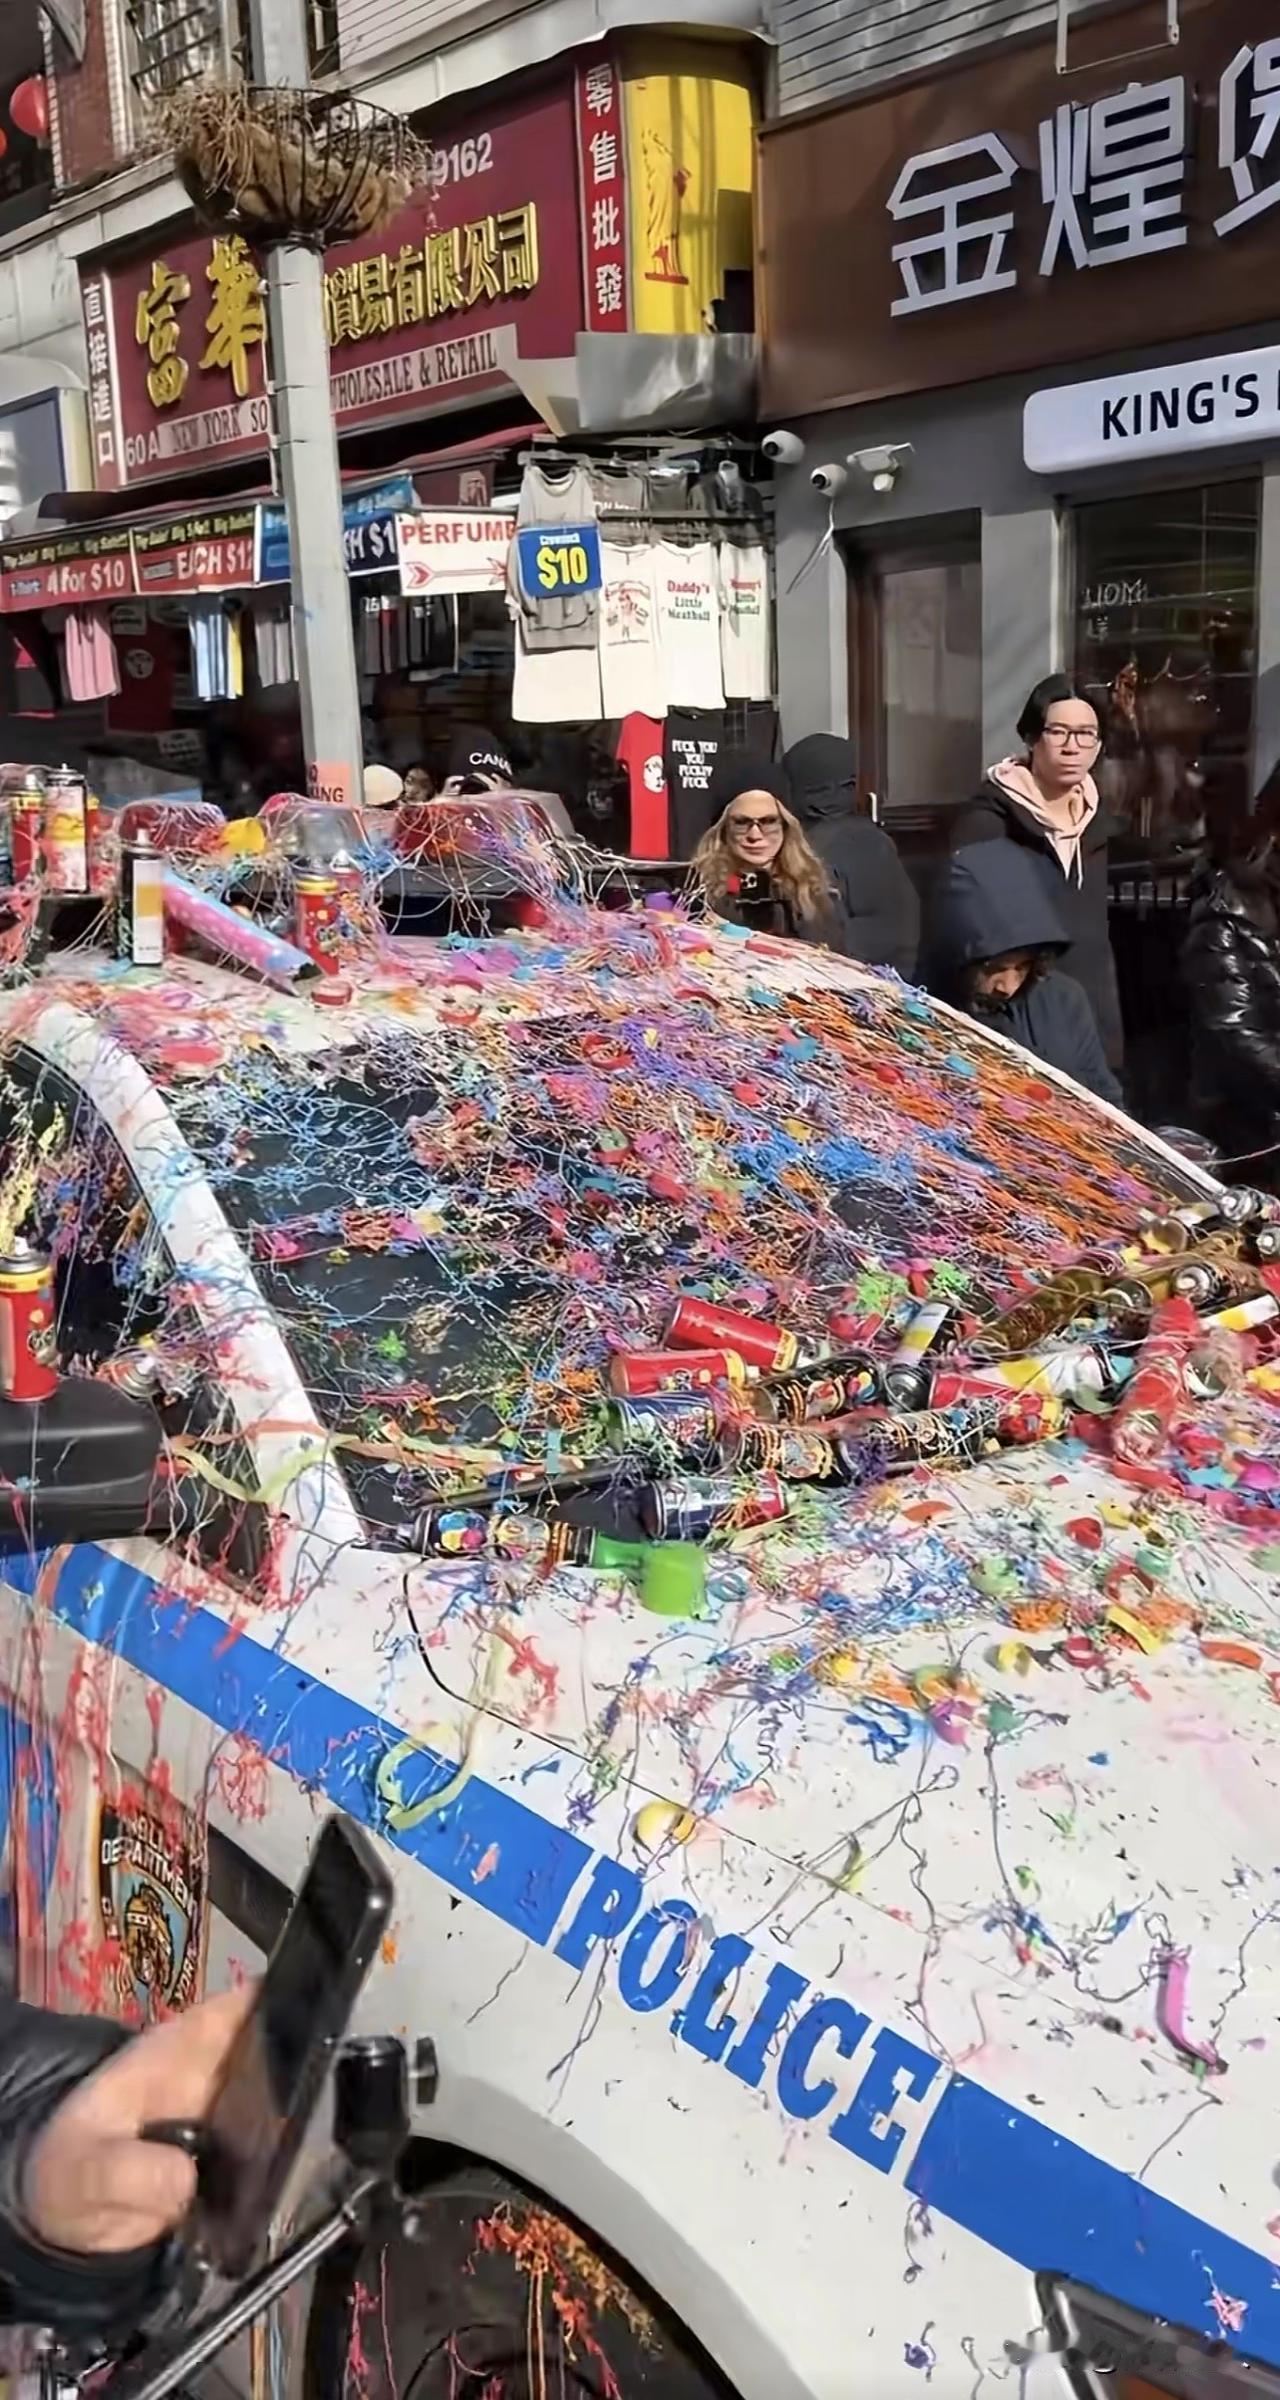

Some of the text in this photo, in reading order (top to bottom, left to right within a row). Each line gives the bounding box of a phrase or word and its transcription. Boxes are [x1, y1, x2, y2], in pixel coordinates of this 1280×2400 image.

[587, 63, 622, 314] 零售批發
[203, 404, 242, 445] YORK
[419, 350, 431, 388] &
[435, 332, 498, 384] RETAIL
[1103, 373, 1259, 440] KING'S
[46, 567, 59, 597] 4
[61, 565, 87, 593] for
[90, 559, 126, 592] $10
[536, 546, 588, 590] $10
[667, 579, 711, 596] Daddy's
[553, 1855, 942, 2175] POLICE
